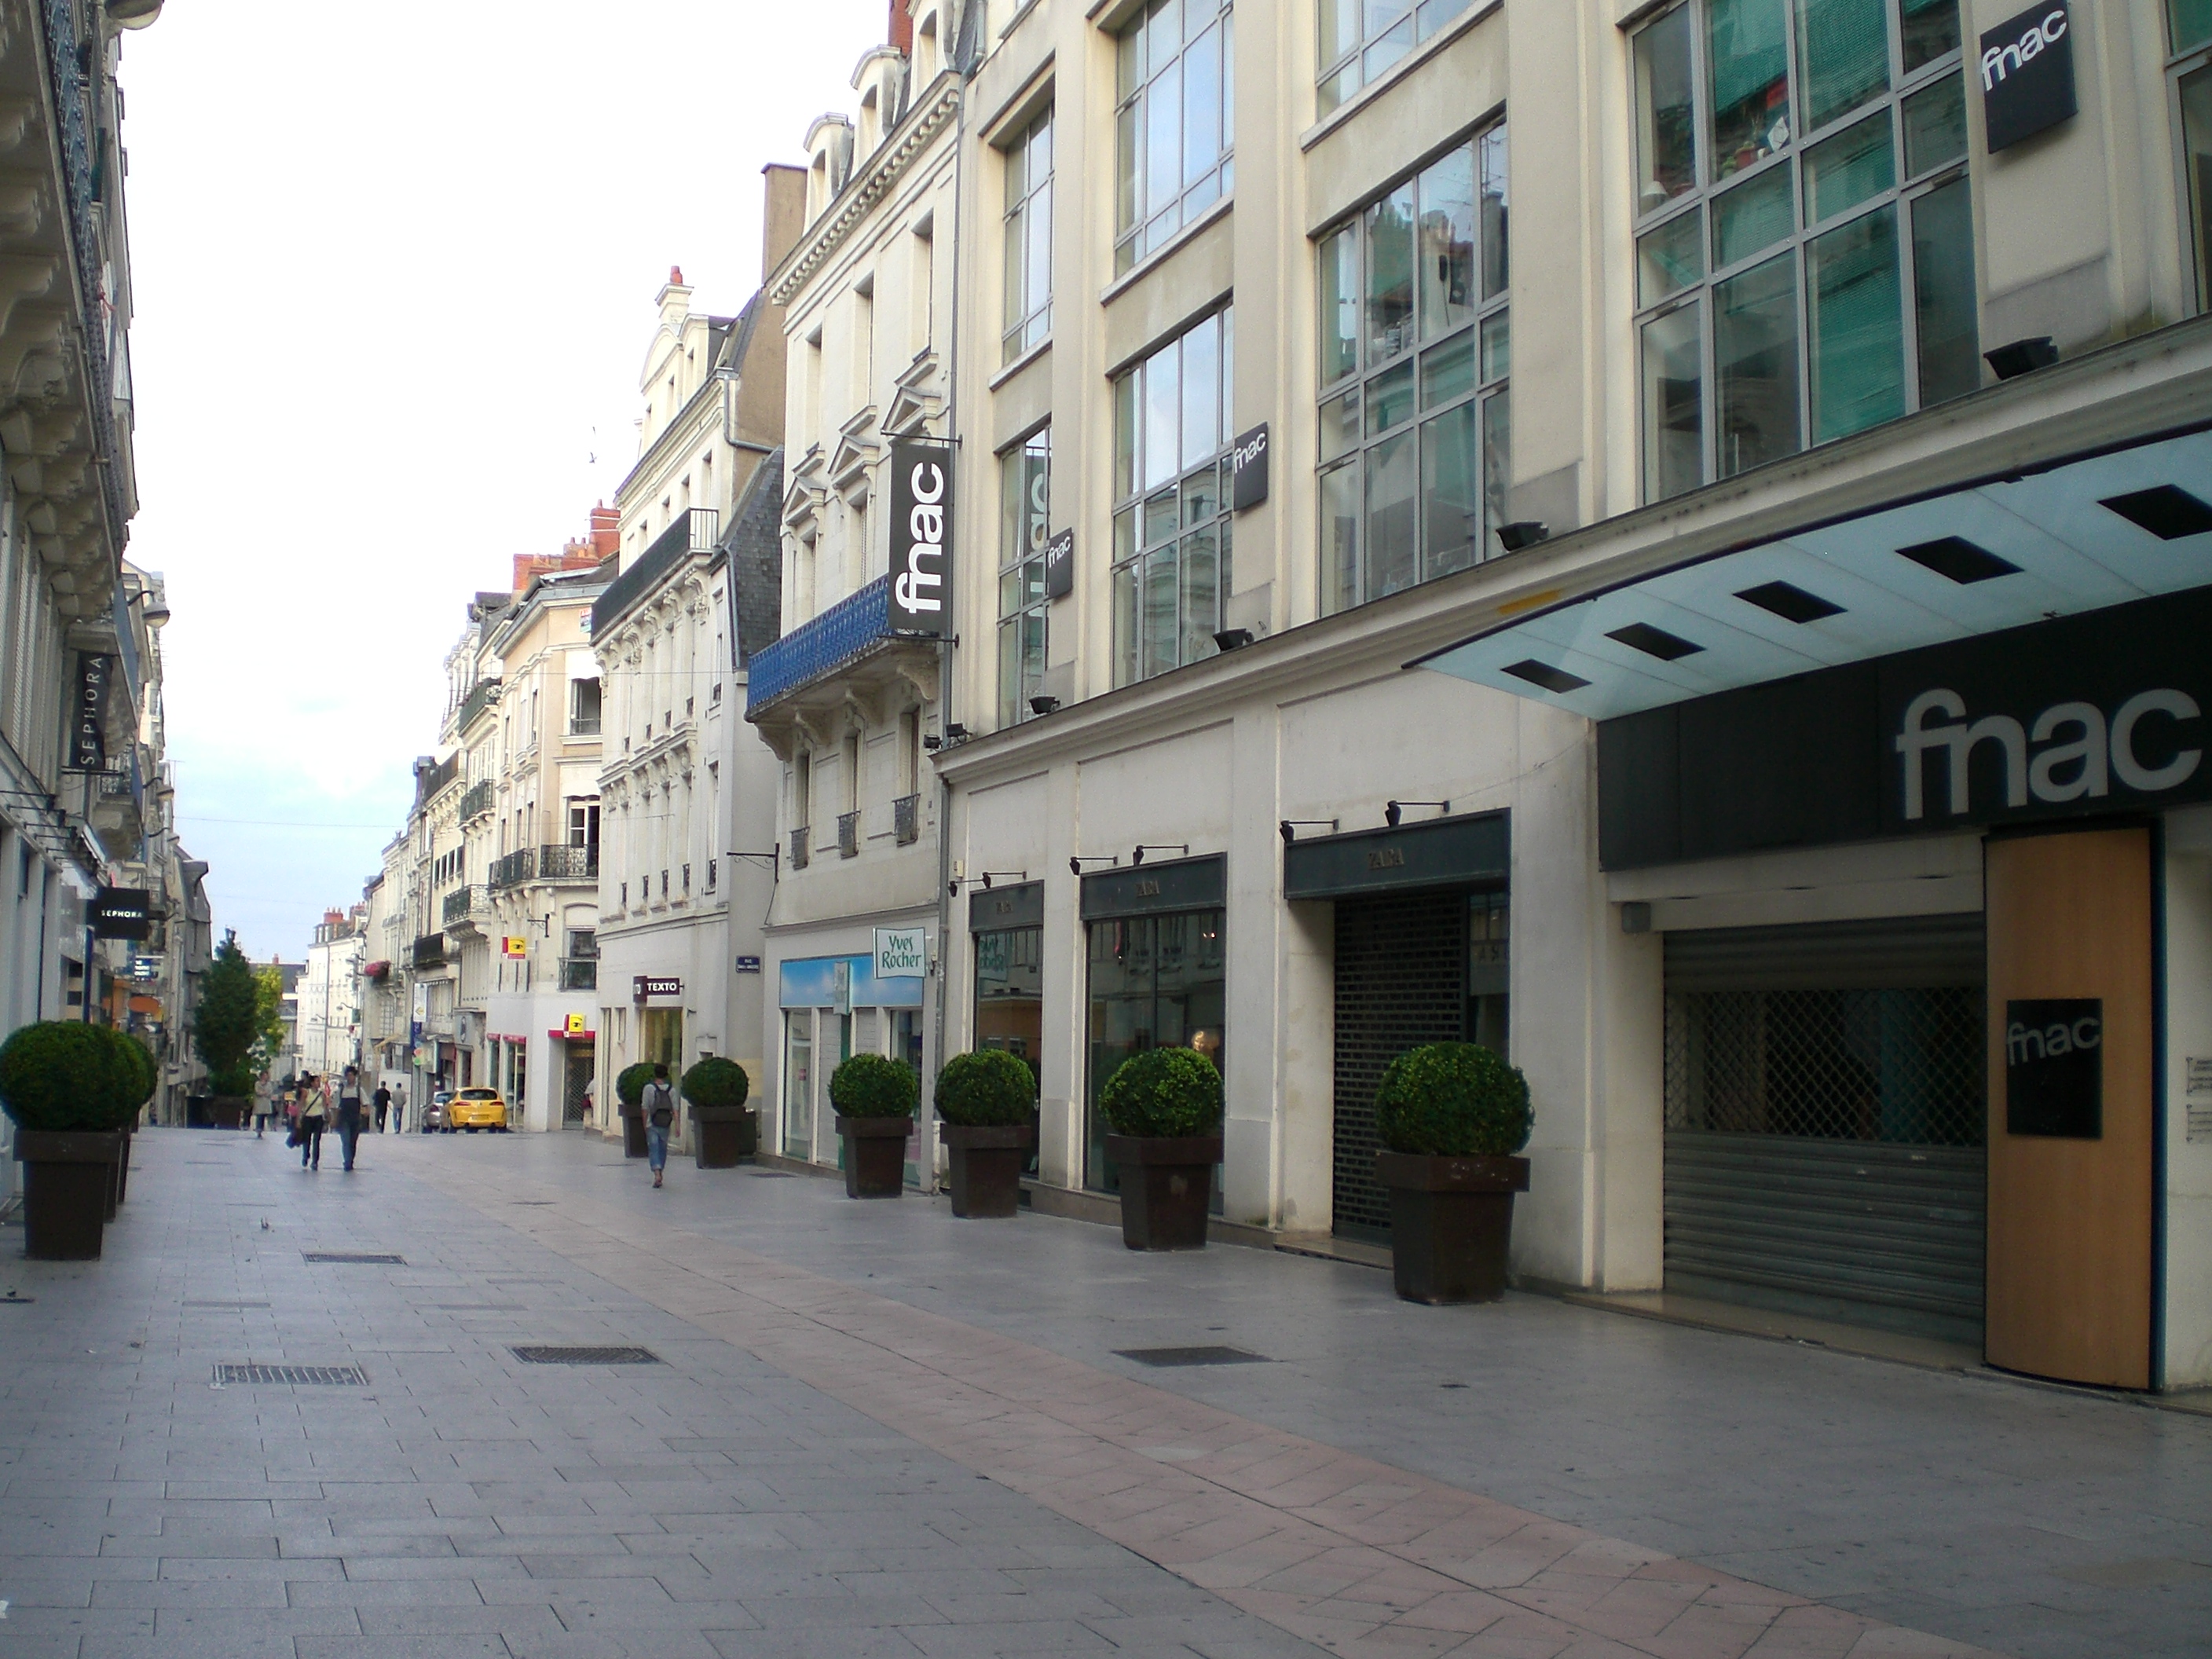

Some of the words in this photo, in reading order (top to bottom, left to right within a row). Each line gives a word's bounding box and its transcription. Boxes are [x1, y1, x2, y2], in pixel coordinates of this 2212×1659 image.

[1982, 10, 2067, 91] fnac
[1233, 433, 1266, 474] fnac
[895, 462, 944, 613] fnac
[1049, 536, 1071, 568] fnac
[80, 657, 102, 765] SEPHORA
[1895, 688, 2203, 820] fnac
[881, 950, 922, 969] Rocher
[888, 935, 914, 952] Yves
[646, 982, 677, 991] TEXTO
[2007, 1017, 2101, 1066] fnac
